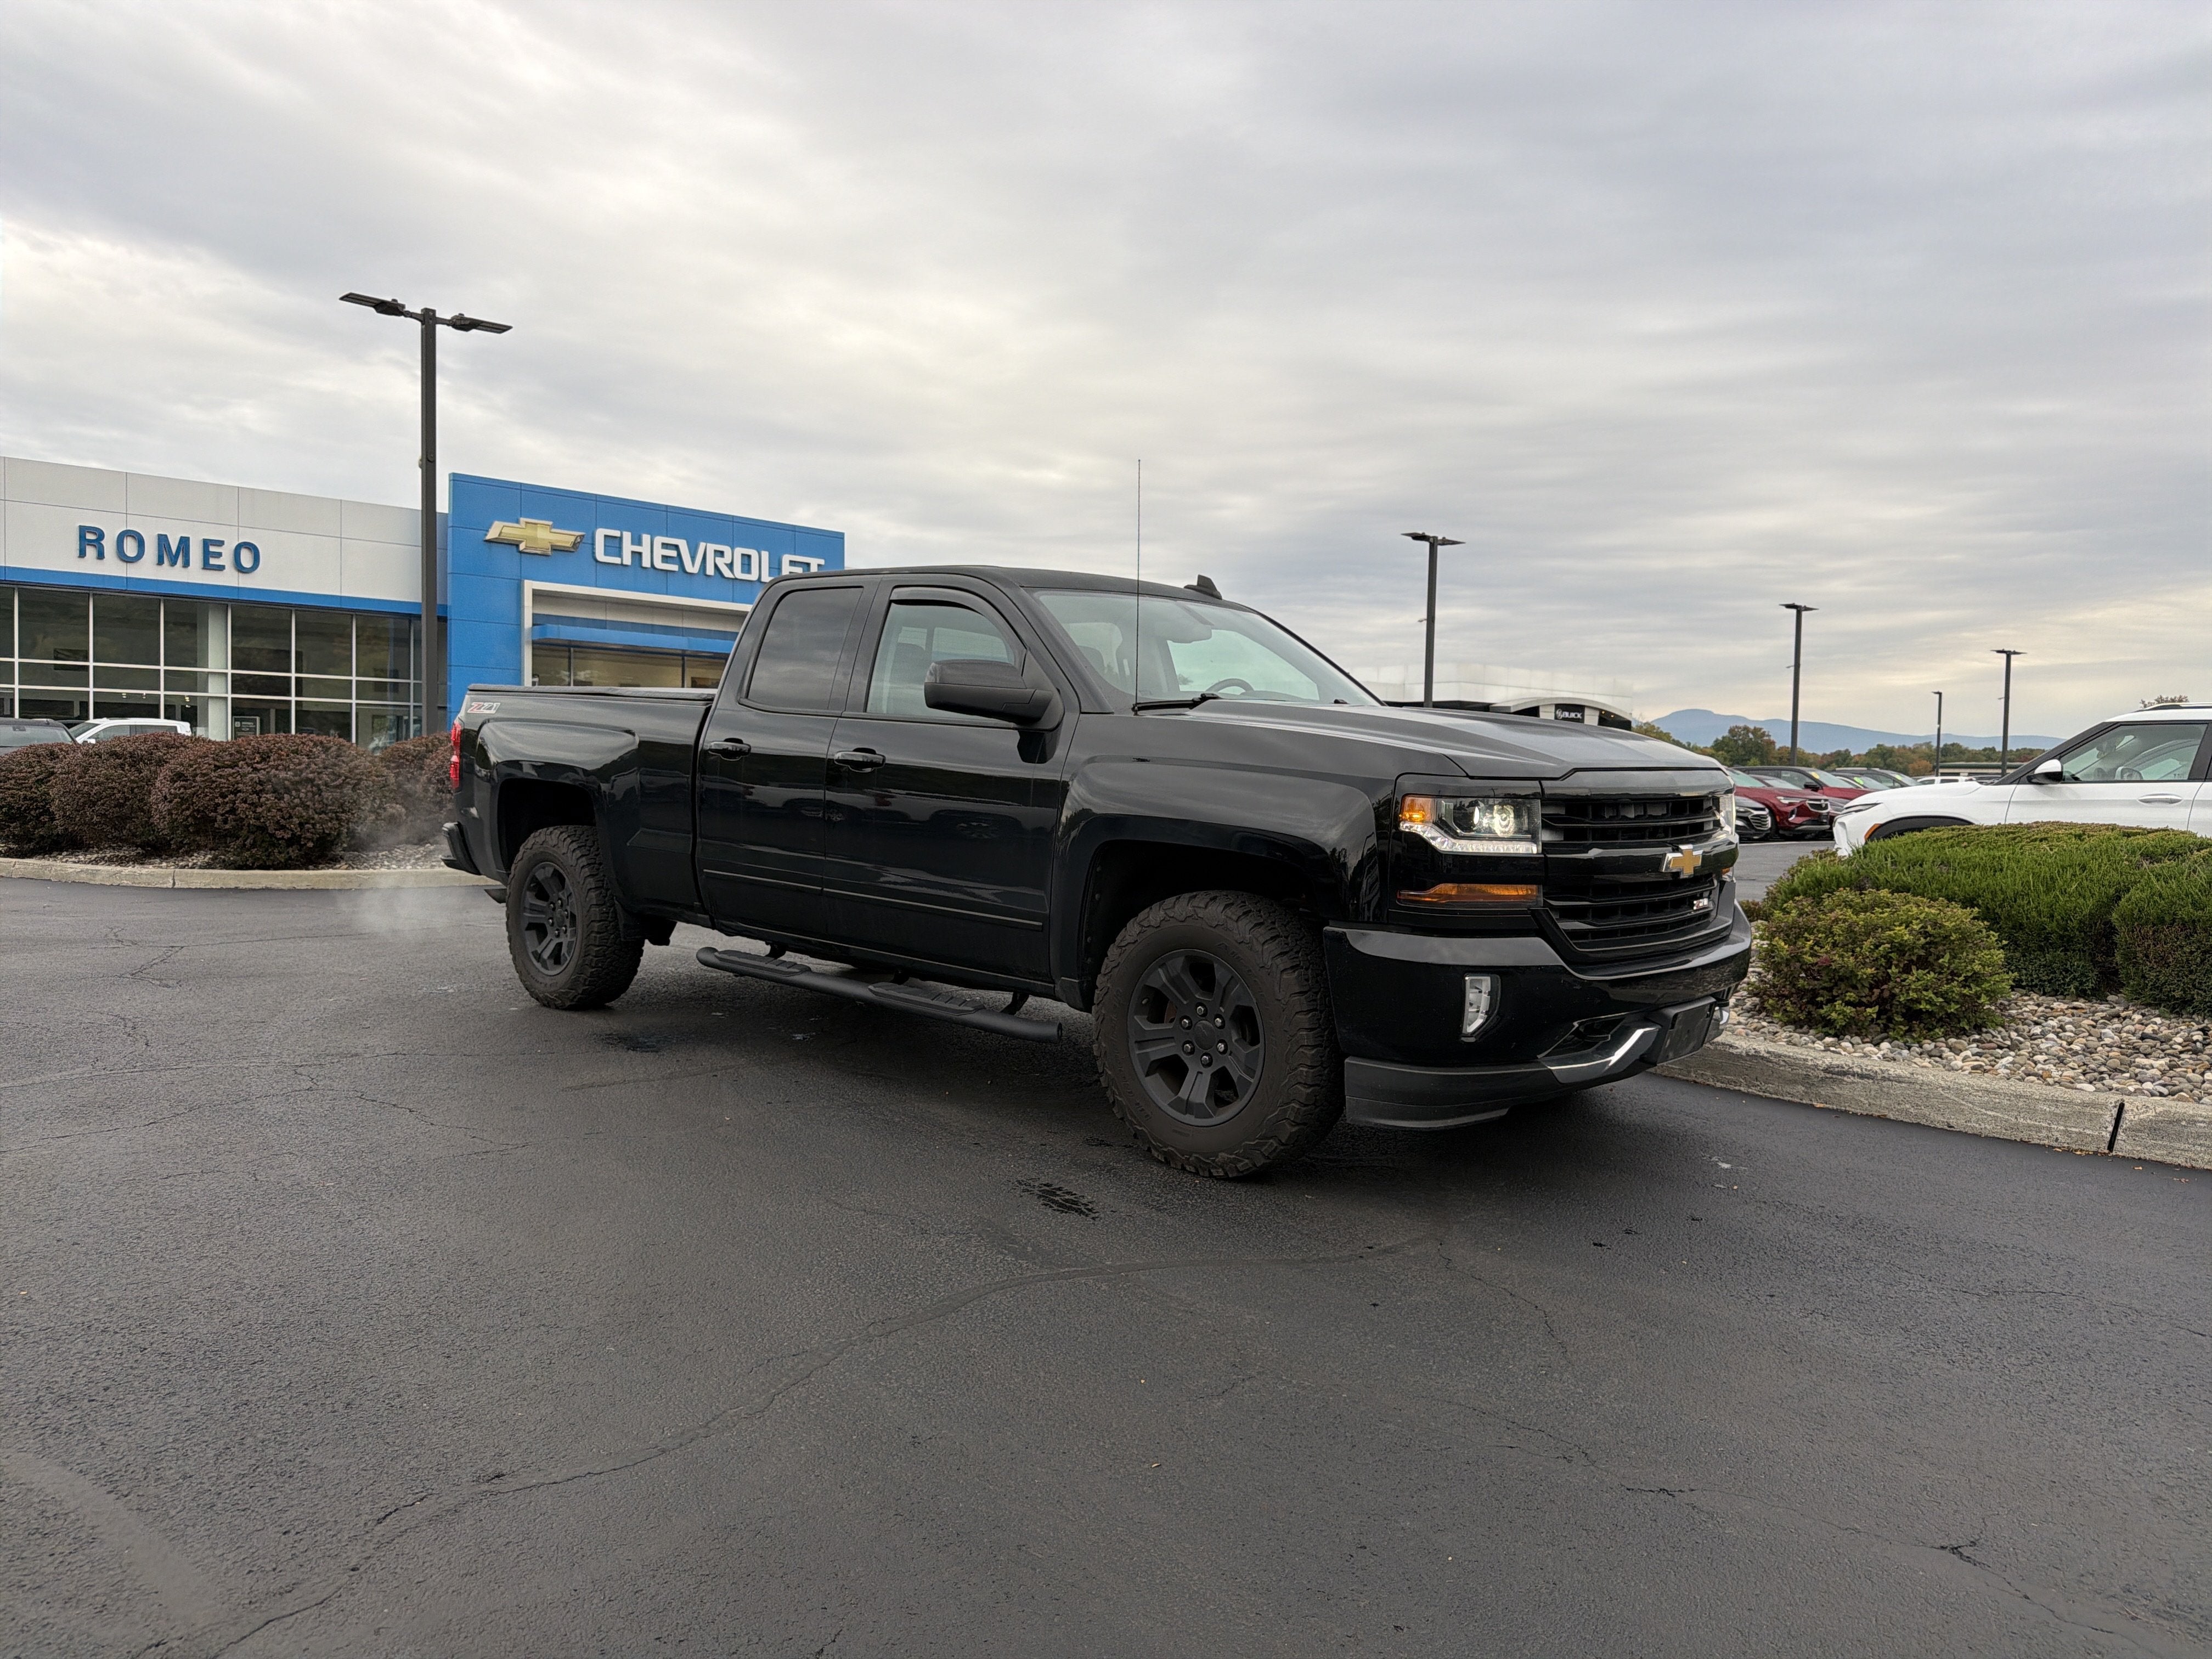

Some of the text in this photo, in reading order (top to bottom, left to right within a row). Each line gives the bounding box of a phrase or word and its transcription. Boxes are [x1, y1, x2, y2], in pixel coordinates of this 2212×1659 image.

[78, 524, 261, 574] ROMEO
[467, 702, 501, 714] Z71
[1562, 711, 1582, 719] BUICK
